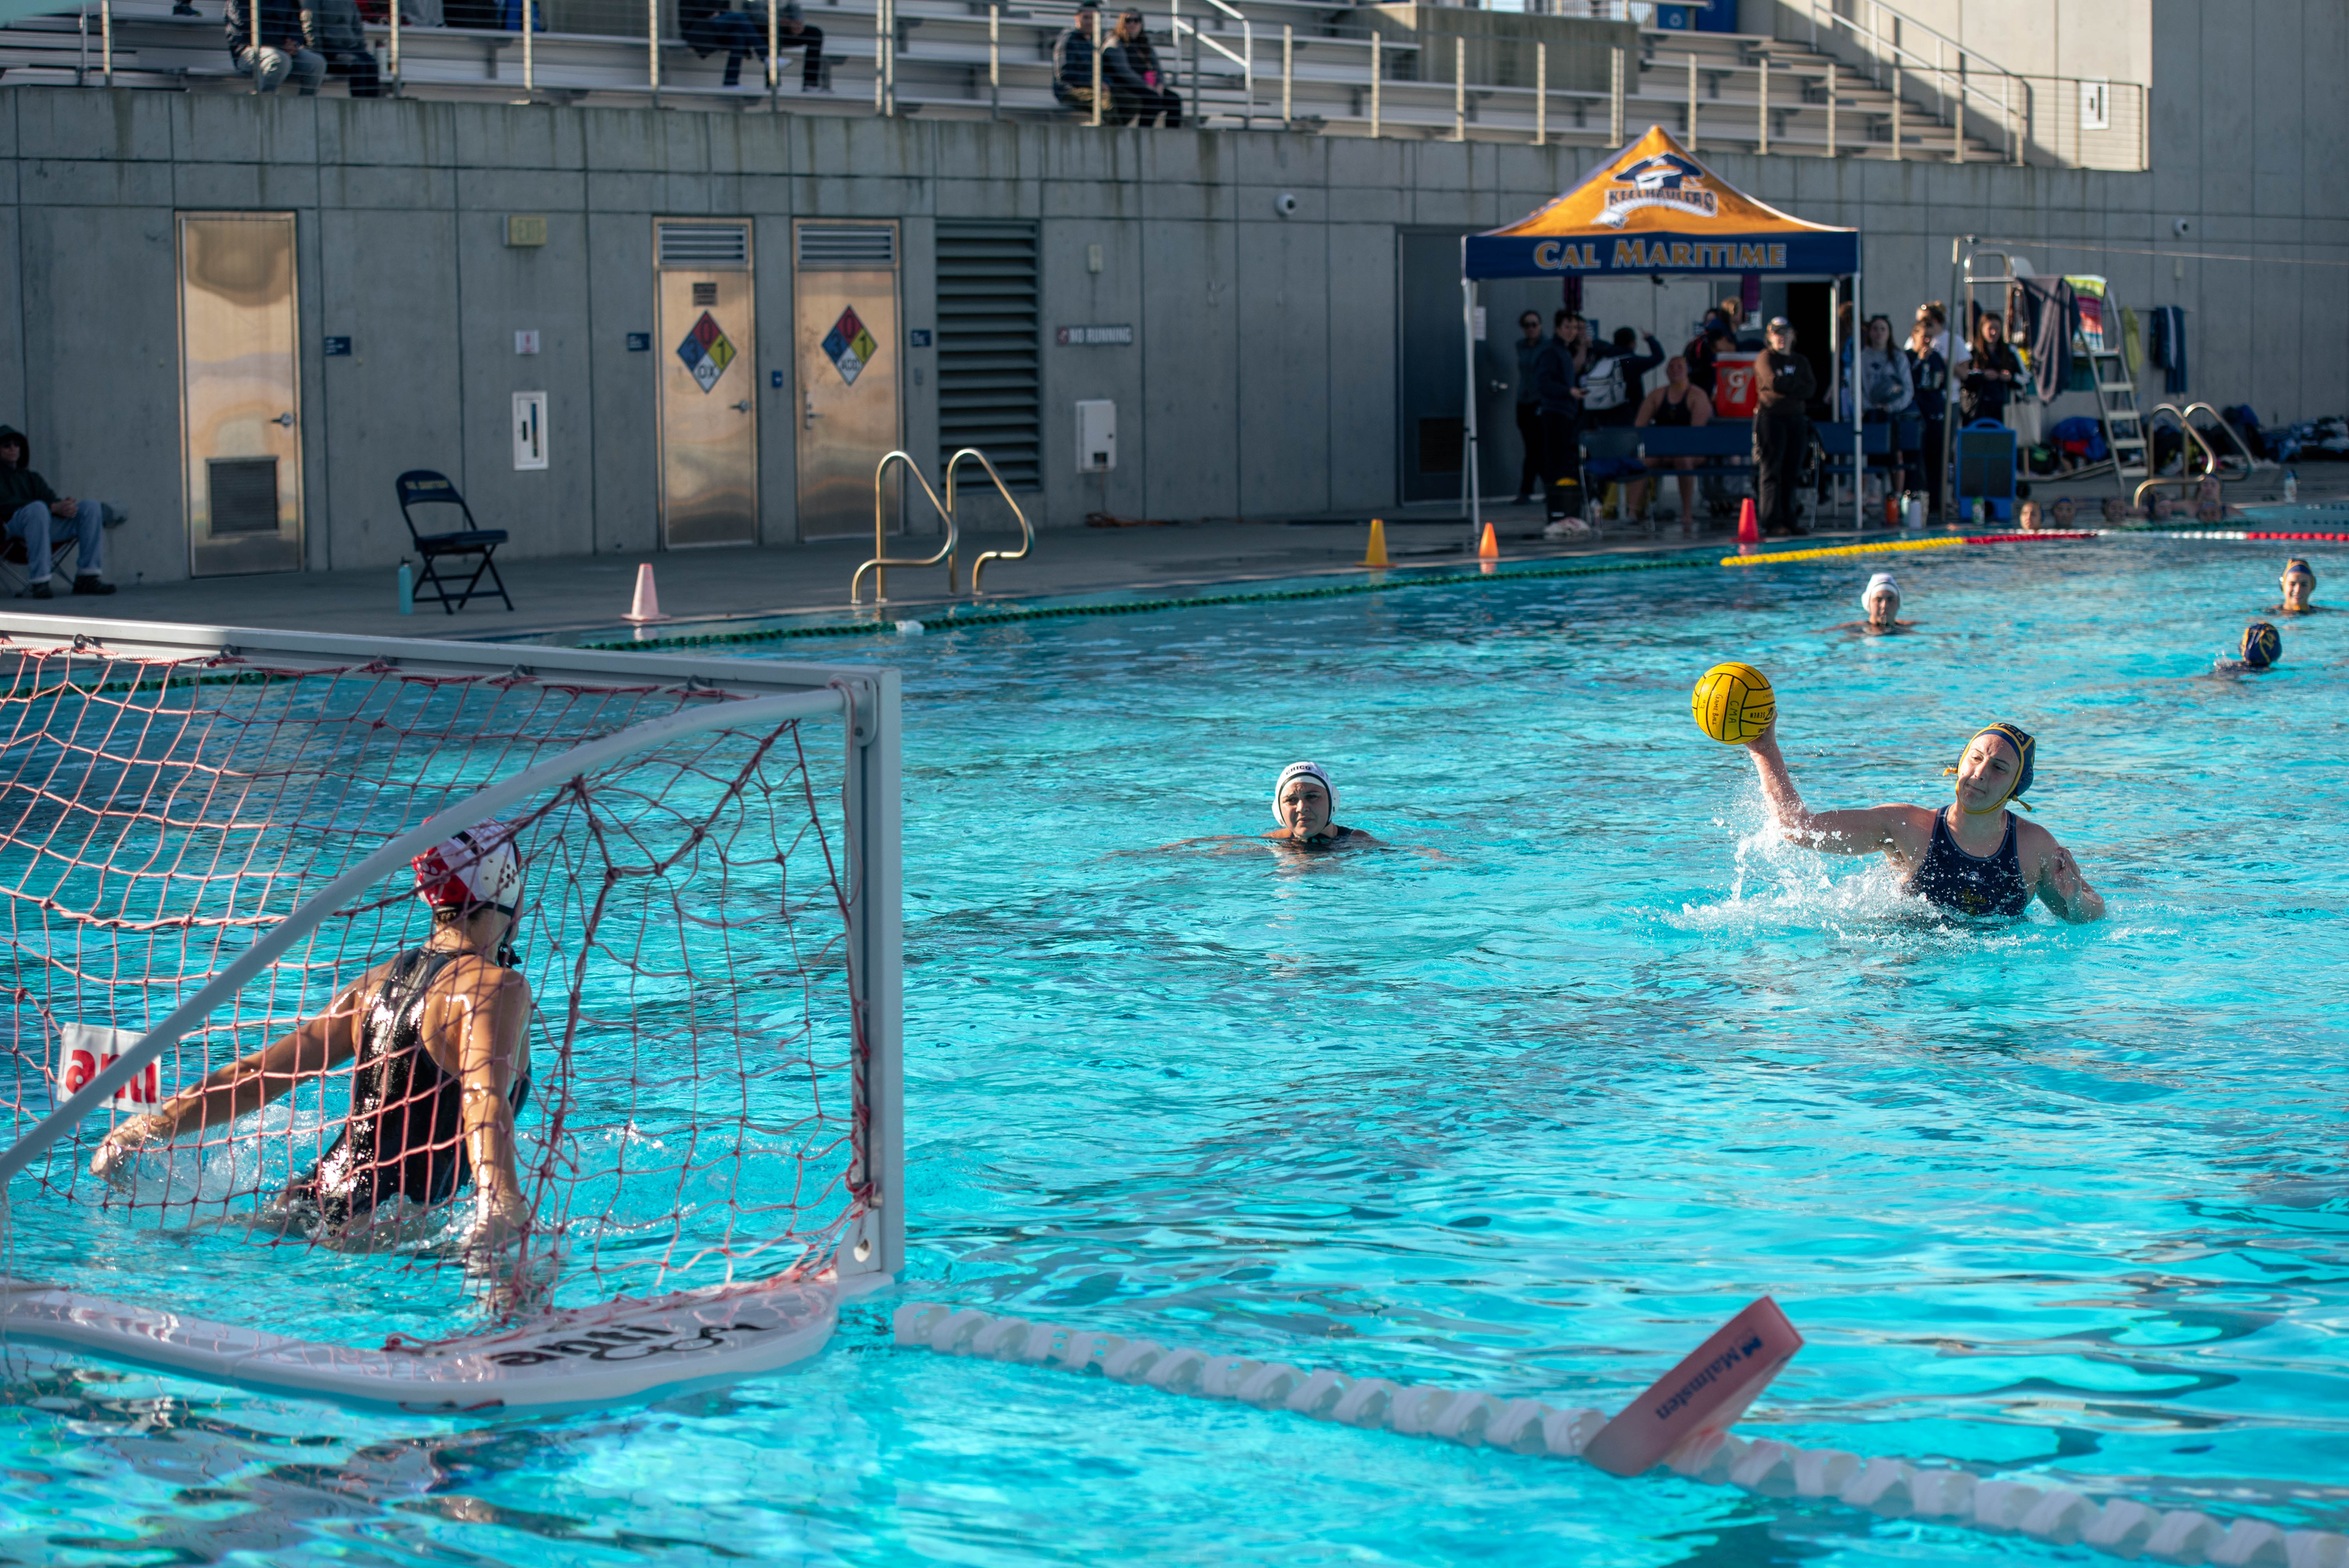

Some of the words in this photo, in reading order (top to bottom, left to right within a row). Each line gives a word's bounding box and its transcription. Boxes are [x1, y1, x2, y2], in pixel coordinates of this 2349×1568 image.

[1533, 239, 1602, 270] CAL
[1611, 239, 1788, 269] MARITIME
[1069, 328, 1085, 344] NO
[1086, 327, 1132, 344] RUNNING
[1728, 700, 1739, 724] CMA
[487, 1323, 678, 1367] anti
[1656, 1347, 1742, 1420] Malmsten
